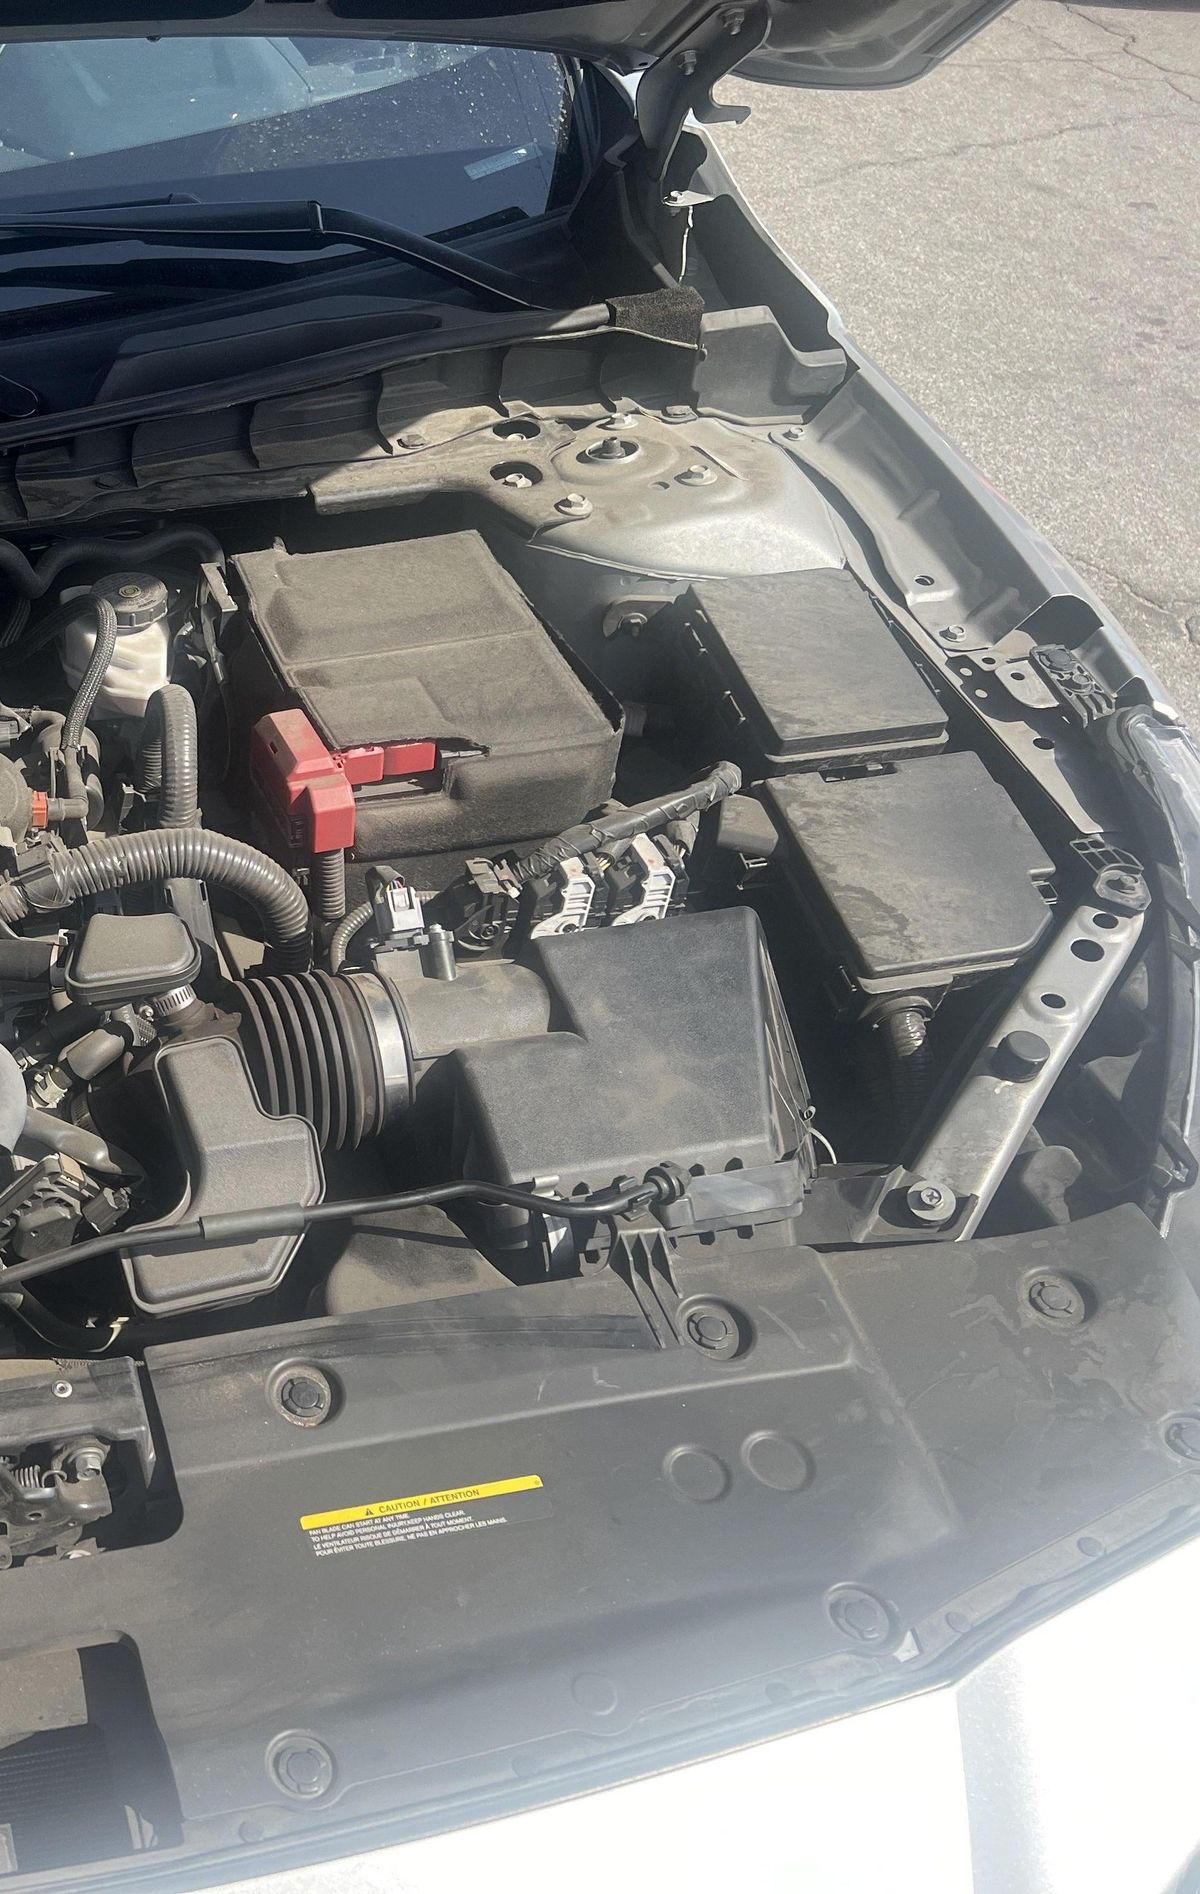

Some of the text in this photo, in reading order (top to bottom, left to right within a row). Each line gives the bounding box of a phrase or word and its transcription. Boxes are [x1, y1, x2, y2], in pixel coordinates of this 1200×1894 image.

[379, 1499, 420, 1513] CAUTION
[430, 1490, 480, 1505] ATTENTION
[320, 1533, 336, 1541] HELP
[337, 1530, 355, 1538] AVOID
[355, 1524, 387, 1535] PERSONAL
[423, 1513, 444, 1522] HANDS
[321, 1525, 341, 1533] BLADE
[355, 1519, 373, 1528] START
[322, 1537, 360, 1549] VENTILATEUR
[430, 1520, 446, 1528] TOUT
[354, 1540, 374, 1550] TOUTE
[416, 1530, 428, 1538] PAS
[438, 1523, 475, 1534] APPROCHER
[475, 1520, 487, 1528] LES
